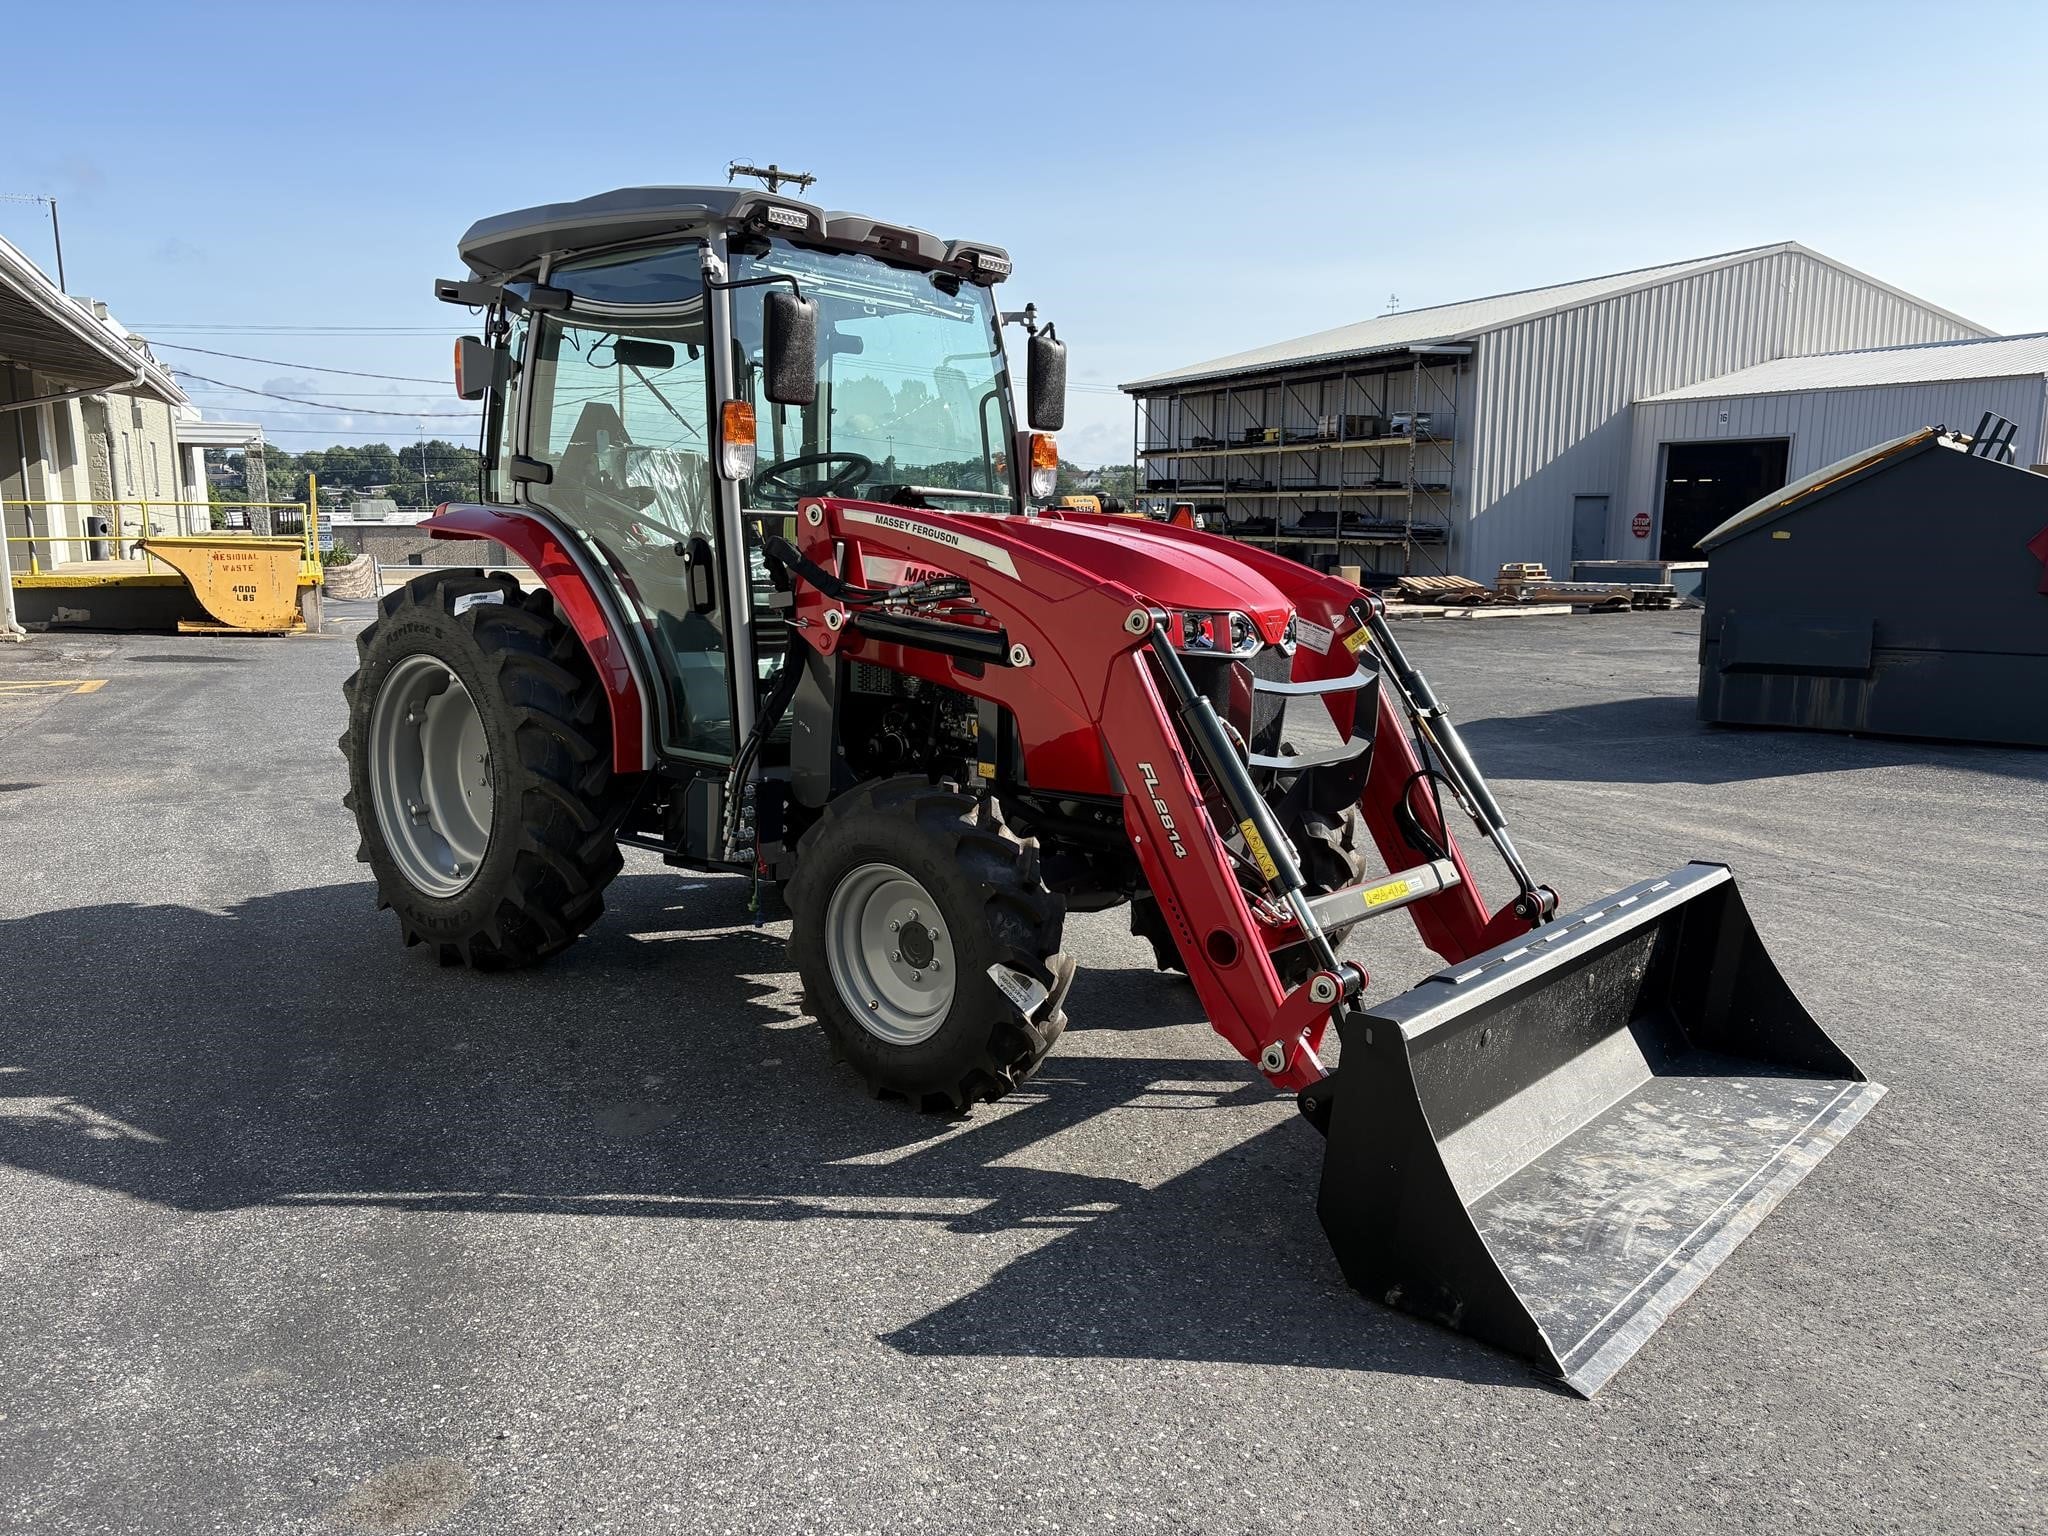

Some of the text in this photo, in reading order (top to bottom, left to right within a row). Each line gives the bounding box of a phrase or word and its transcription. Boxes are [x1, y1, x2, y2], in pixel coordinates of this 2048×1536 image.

[1720, 413, 1728, 422] 16
[1633, 518, 1650, 526] STOP
[875, 514, 959, 545] MASSEY FERGUSON
[213, 553, 260, 561] RESIDUAL
[222, 564, 255, 572] WASTE
[904, 566, 960, 583] MAS
[232, 585, 257, 593] 4000
[236, 594, 255, 602] LBS
[1137, 762, 1188, 859] FL.2814
